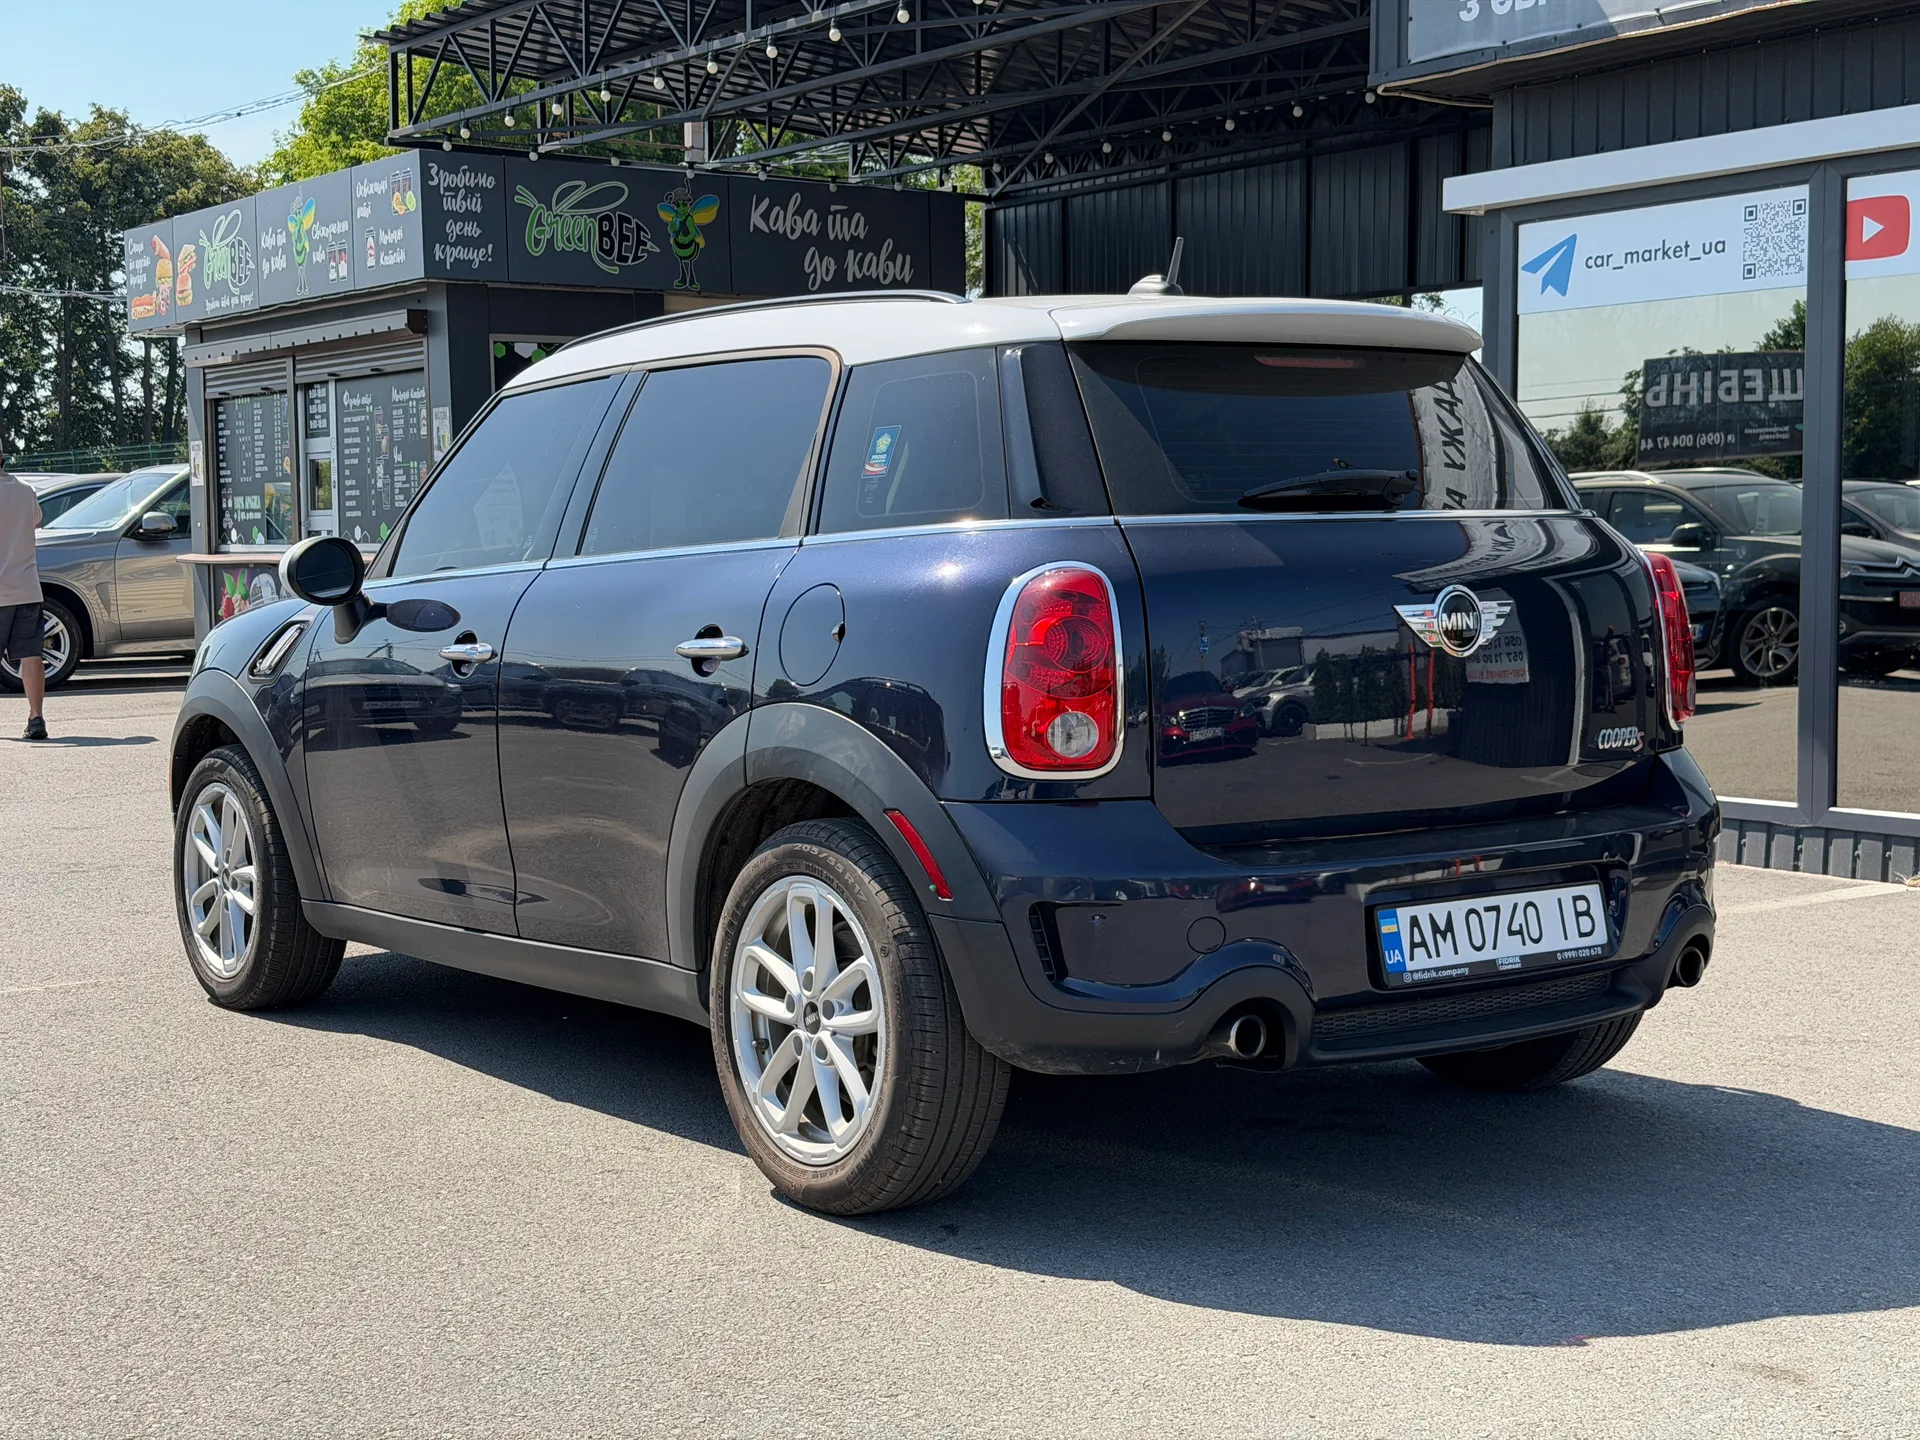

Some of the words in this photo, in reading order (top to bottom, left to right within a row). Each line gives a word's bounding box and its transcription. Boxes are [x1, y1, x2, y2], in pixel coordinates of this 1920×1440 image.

[428, 163, 496, 191] Зробимо
[442, 190, 483, 215] твій
[445, 217, 482, 241] день
[750, 192, 822, 241] Кава
[826, 205, 869, 241] та
[434, 243, 493, 271] краще!
[803, 246, 839, 291] до
[846, 238, 915, 285] кави
[1584, 238, 1726, 271] car_market_ua
[1442, 612, 1479, 631] MINI
[1598, 726, 1638, 750] COOPER
[793, 843, 845, 873] 205/55
[1408, 910, 1459, 962] AM
[1464, 901, 1543, 952] 0740
[1557, 894, 1596, 941] IB
[1384, 949, 1403, 965] UA
[1498, 955, 1521, 965] FIDRIK
[1412, 967, 1469, 981] @fidrik.company
